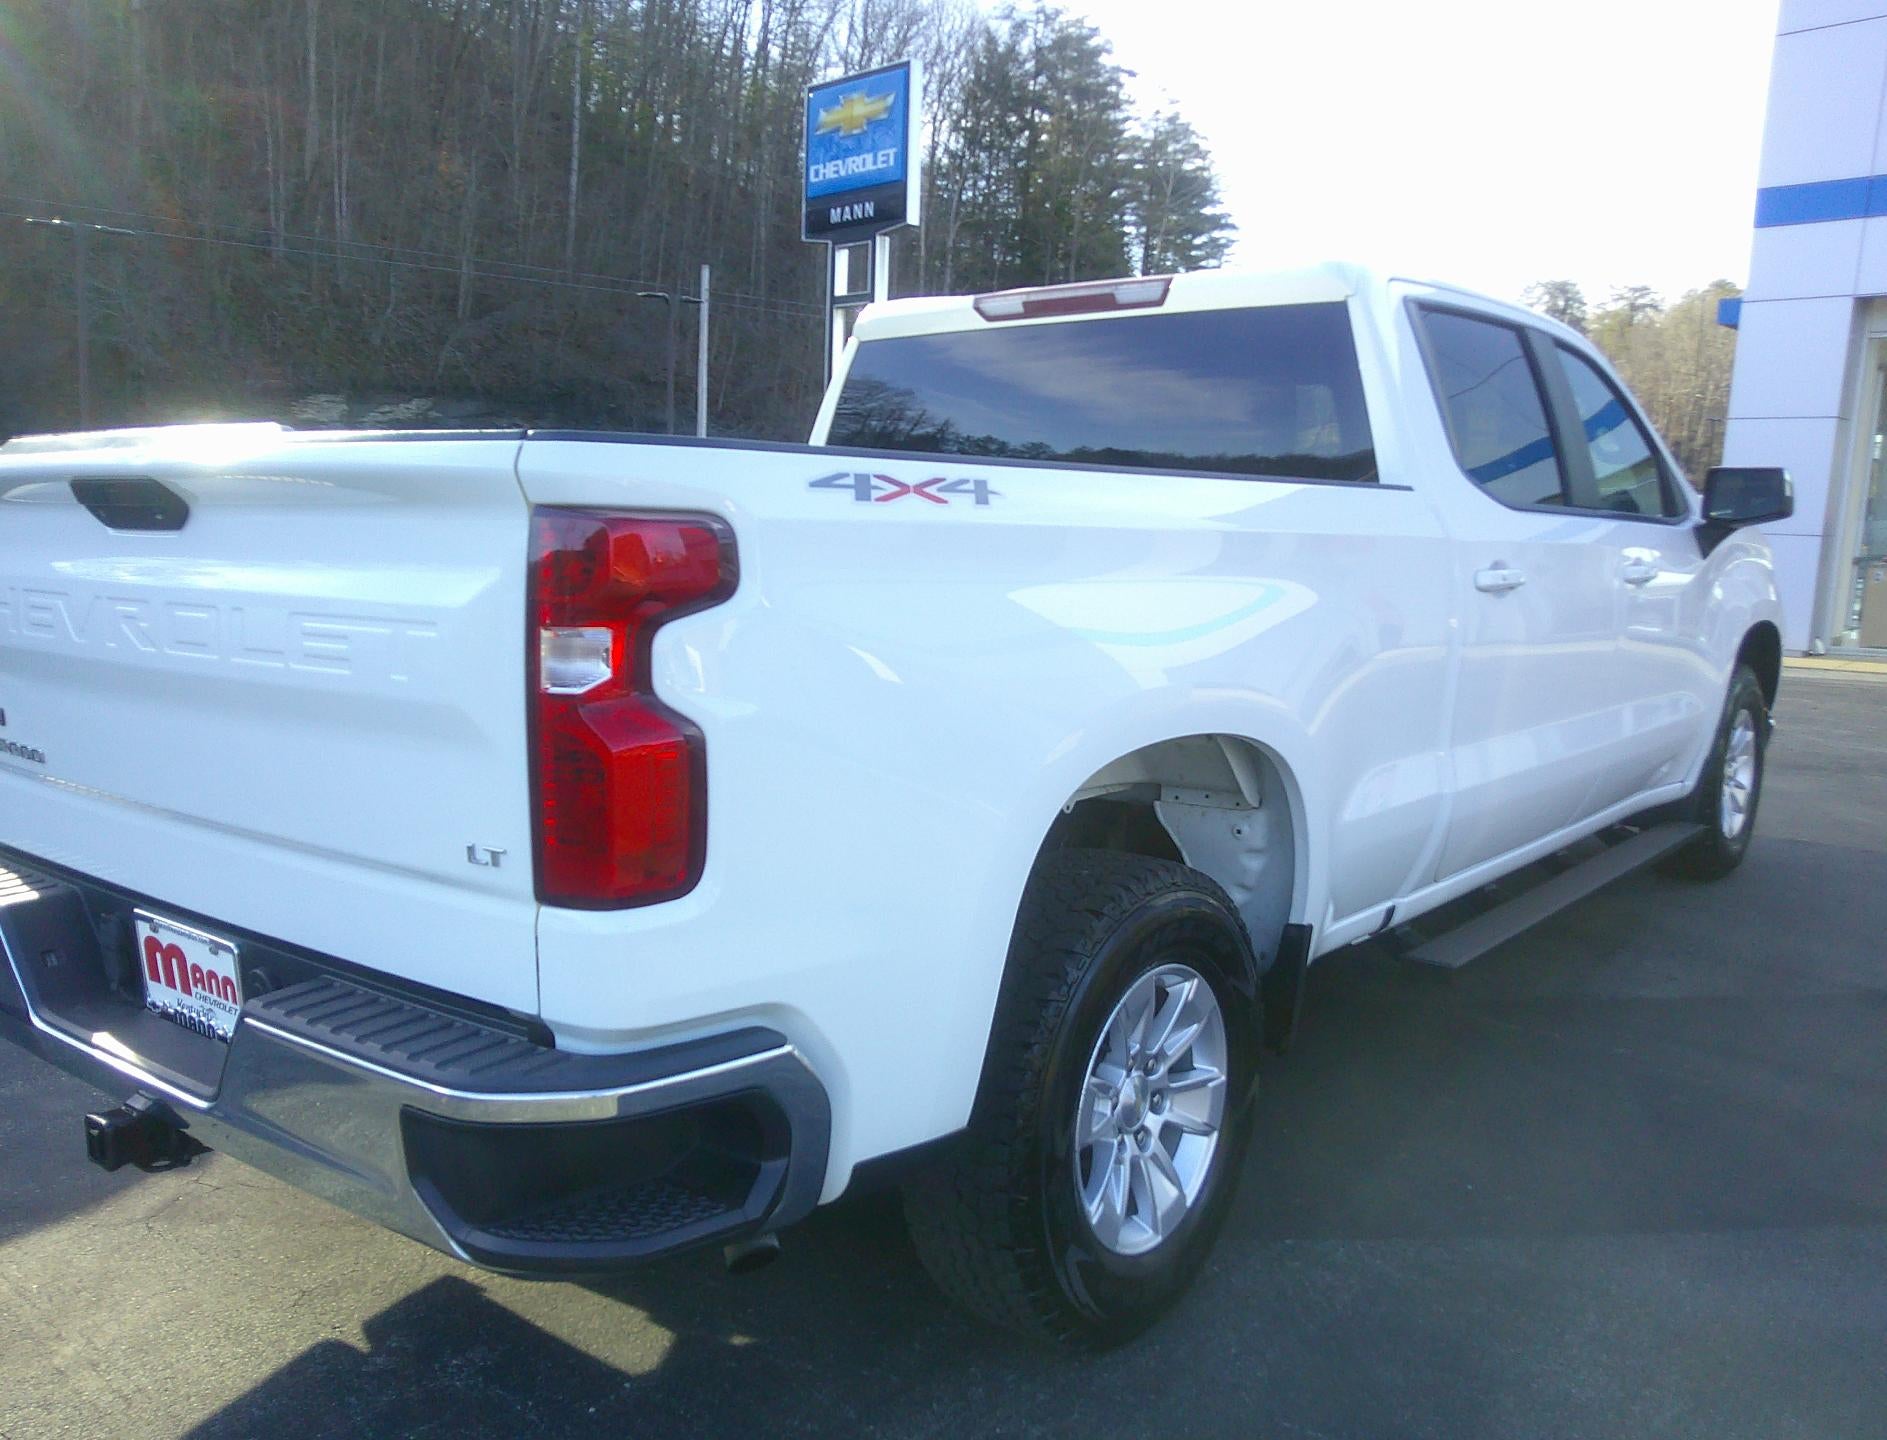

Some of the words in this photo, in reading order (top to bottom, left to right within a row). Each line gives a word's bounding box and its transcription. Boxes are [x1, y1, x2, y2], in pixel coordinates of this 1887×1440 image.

[809, 148, 898, 183] CHEVROLET
[830, 201, 875, 225] MANN
[809, 472, 1002, 505] 4X4
[466, 843, 507, 868] LT
[194, 991, 239, 1017] CHEVROLET
